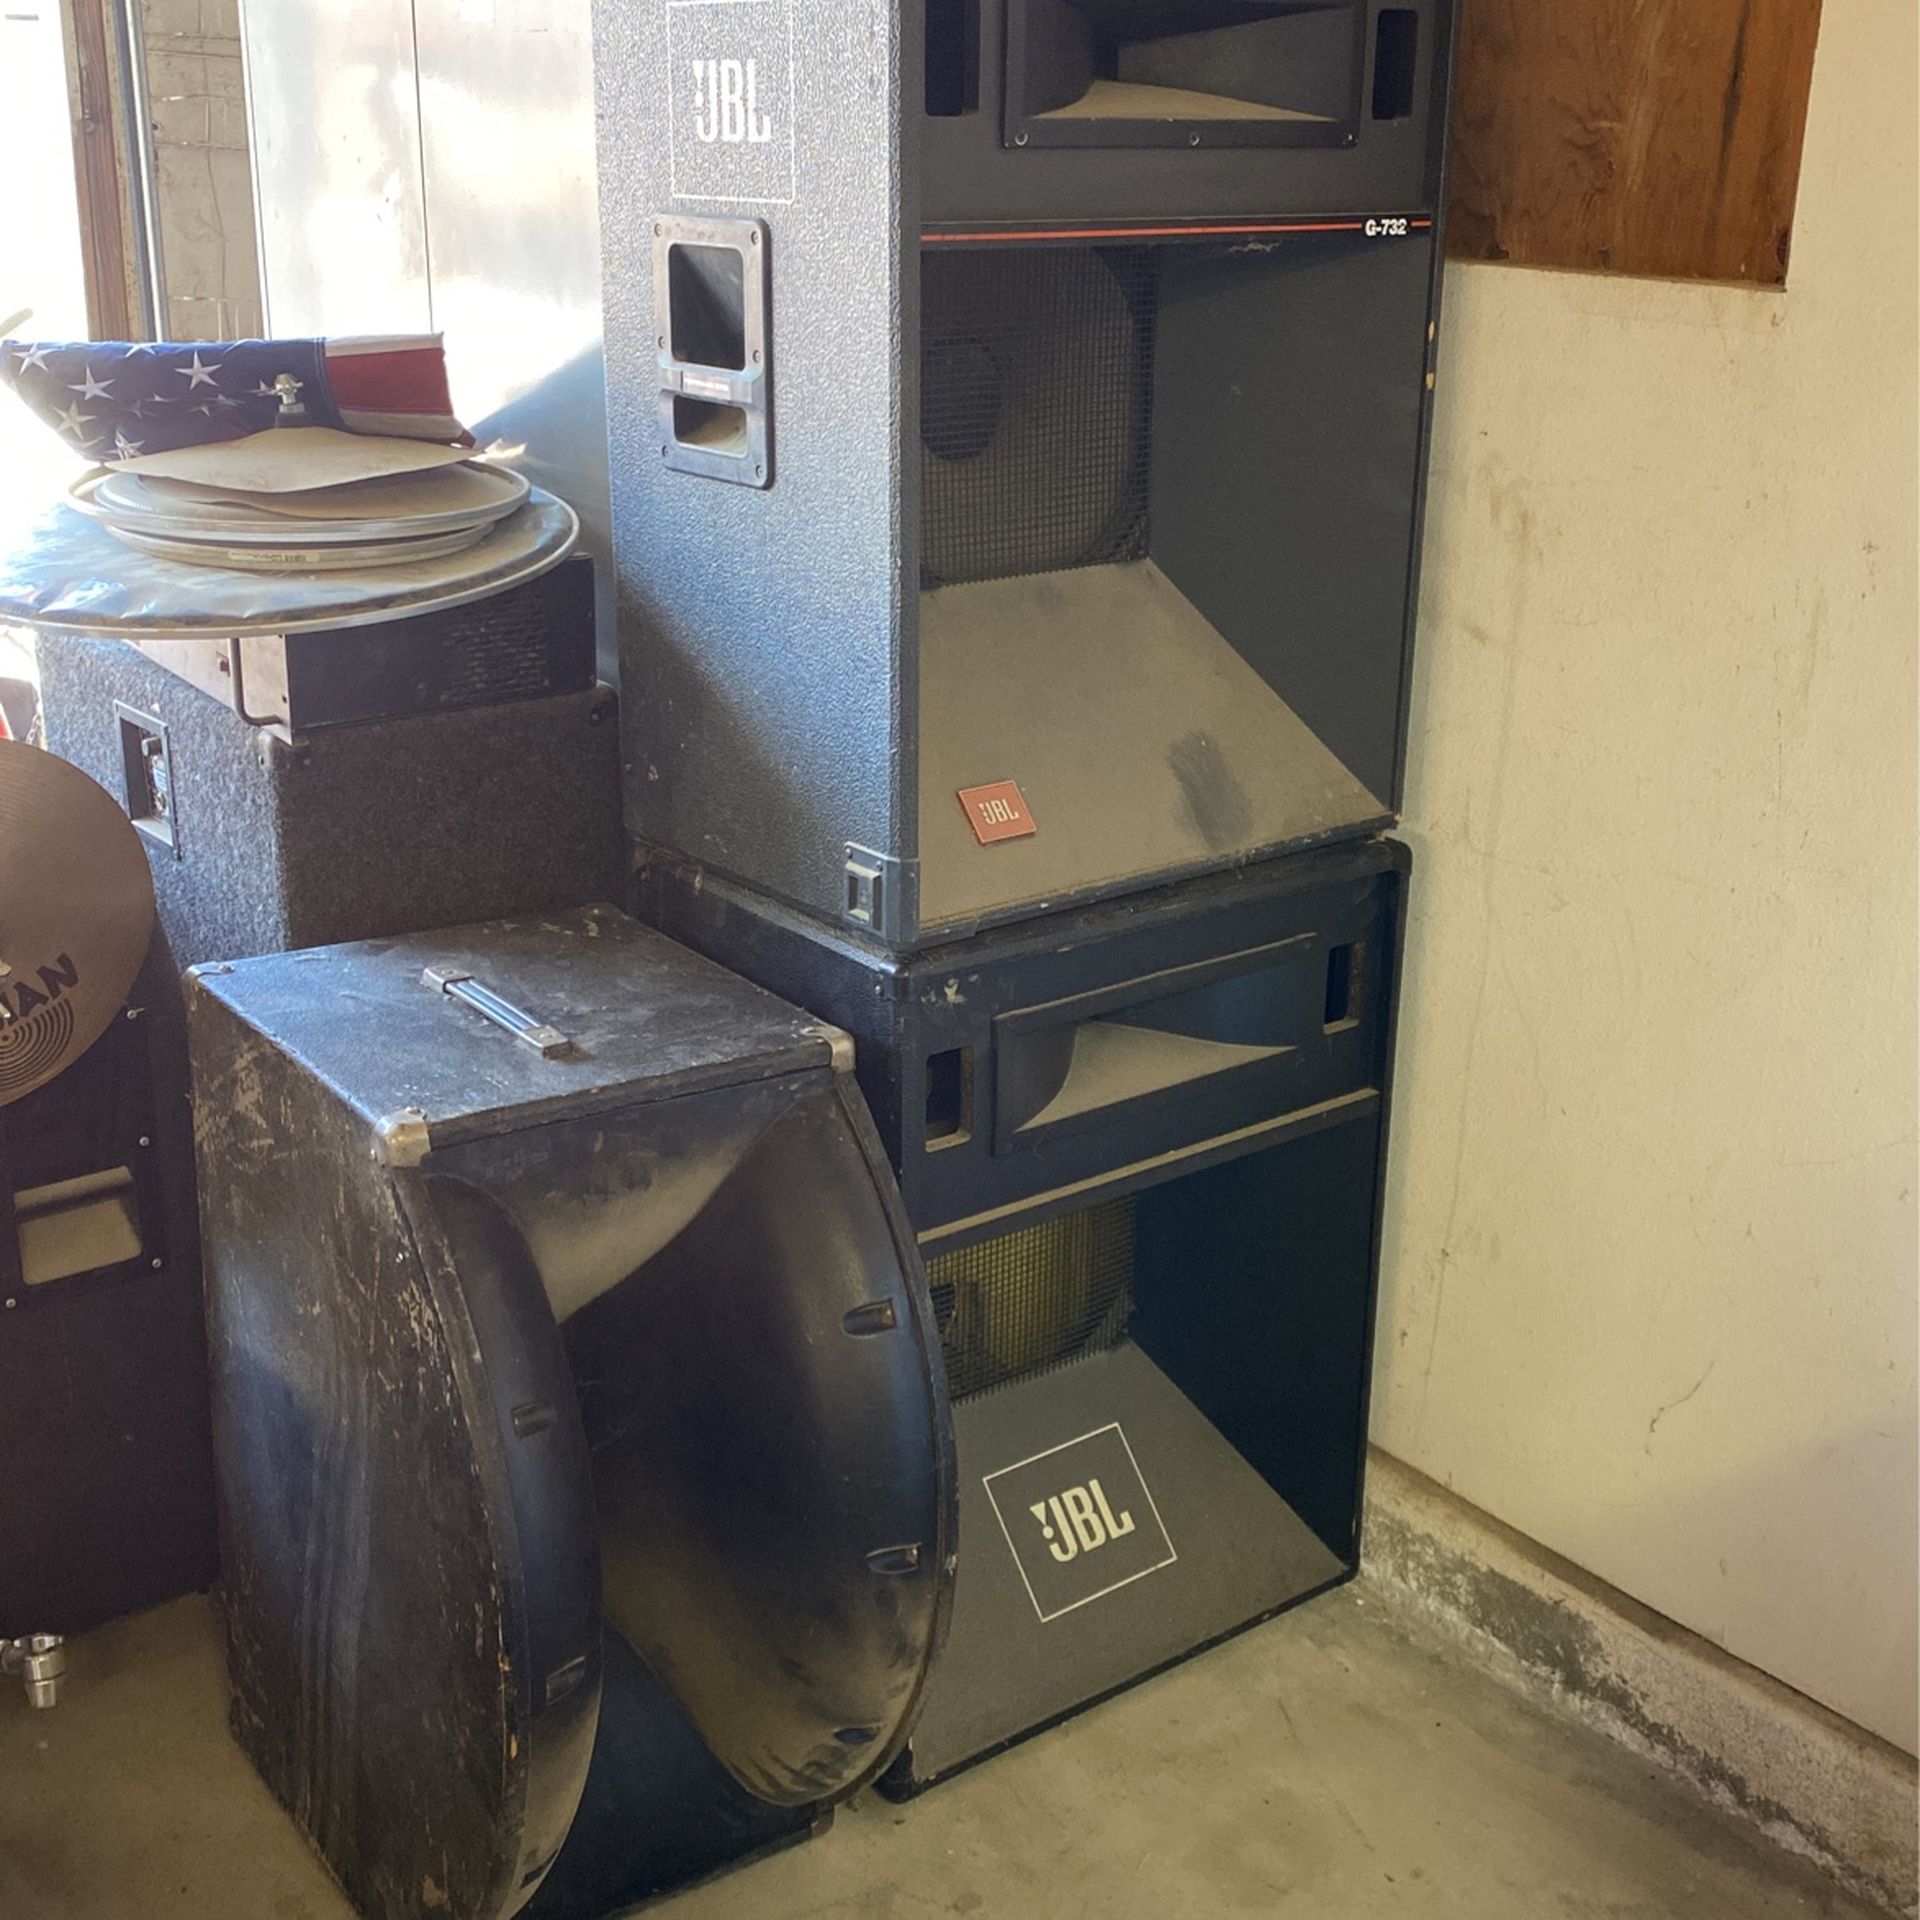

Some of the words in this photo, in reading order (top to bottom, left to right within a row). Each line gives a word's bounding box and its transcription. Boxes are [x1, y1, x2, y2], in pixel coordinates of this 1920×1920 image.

[692, 59, 771, 142] JBL
[1365, 218, 1408, 236] G-732
[978, 798, 1020, 825] JBL
[0, 953, 79, 1026] IAN
[1029, 1478, 1136, 1562] JBL
